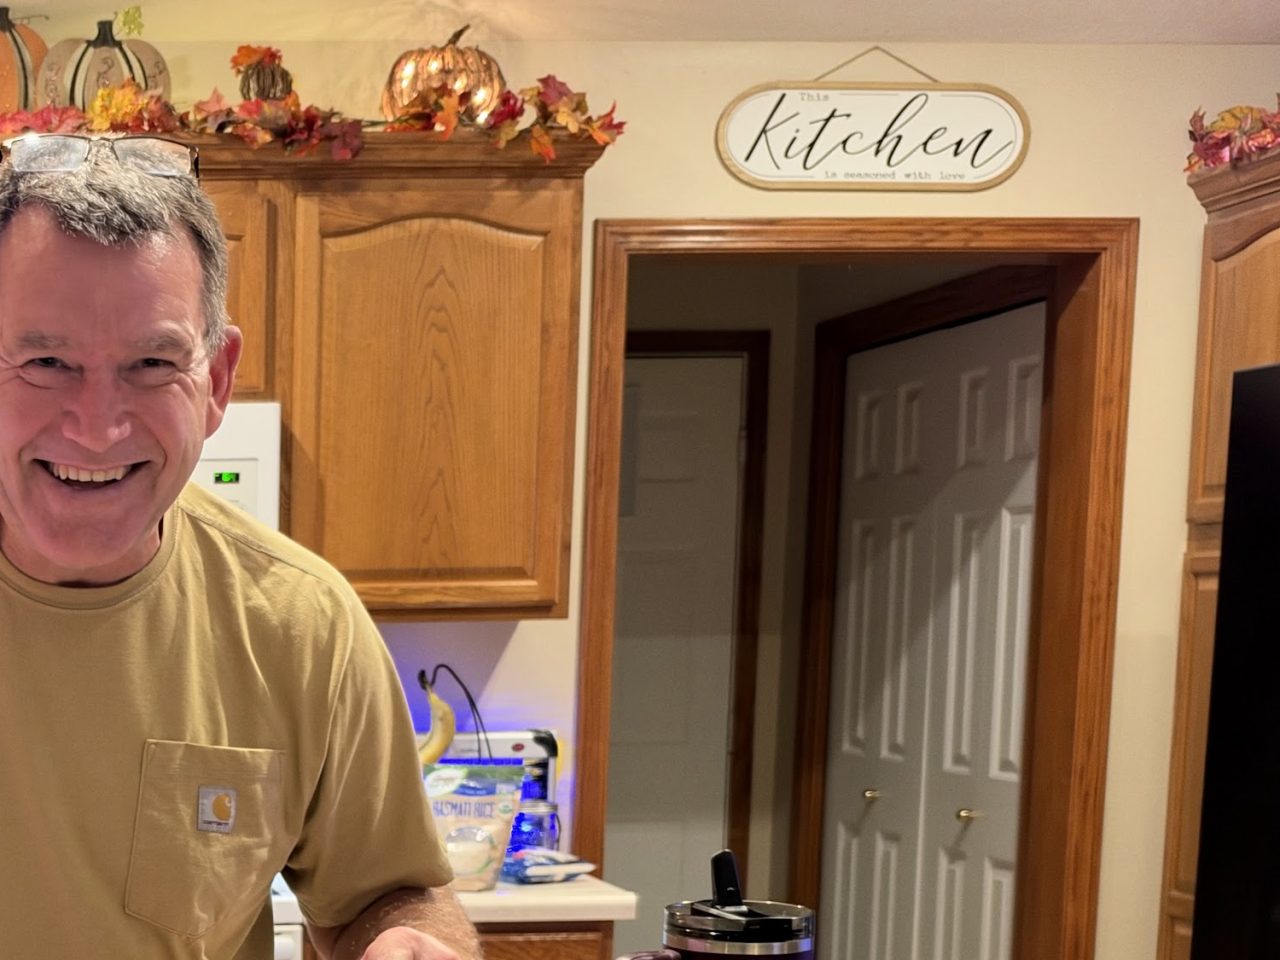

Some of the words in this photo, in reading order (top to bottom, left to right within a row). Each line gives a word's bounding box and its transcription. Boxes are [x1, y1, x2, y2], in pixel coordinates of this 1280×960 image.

[799, 92, 829, 102] This
[744, 92, 1014, 170] Kitchen
[843, 171, 896, 180] seasoned
[904, 171, 932, 180] with
[939, 171, 966, 180] love
